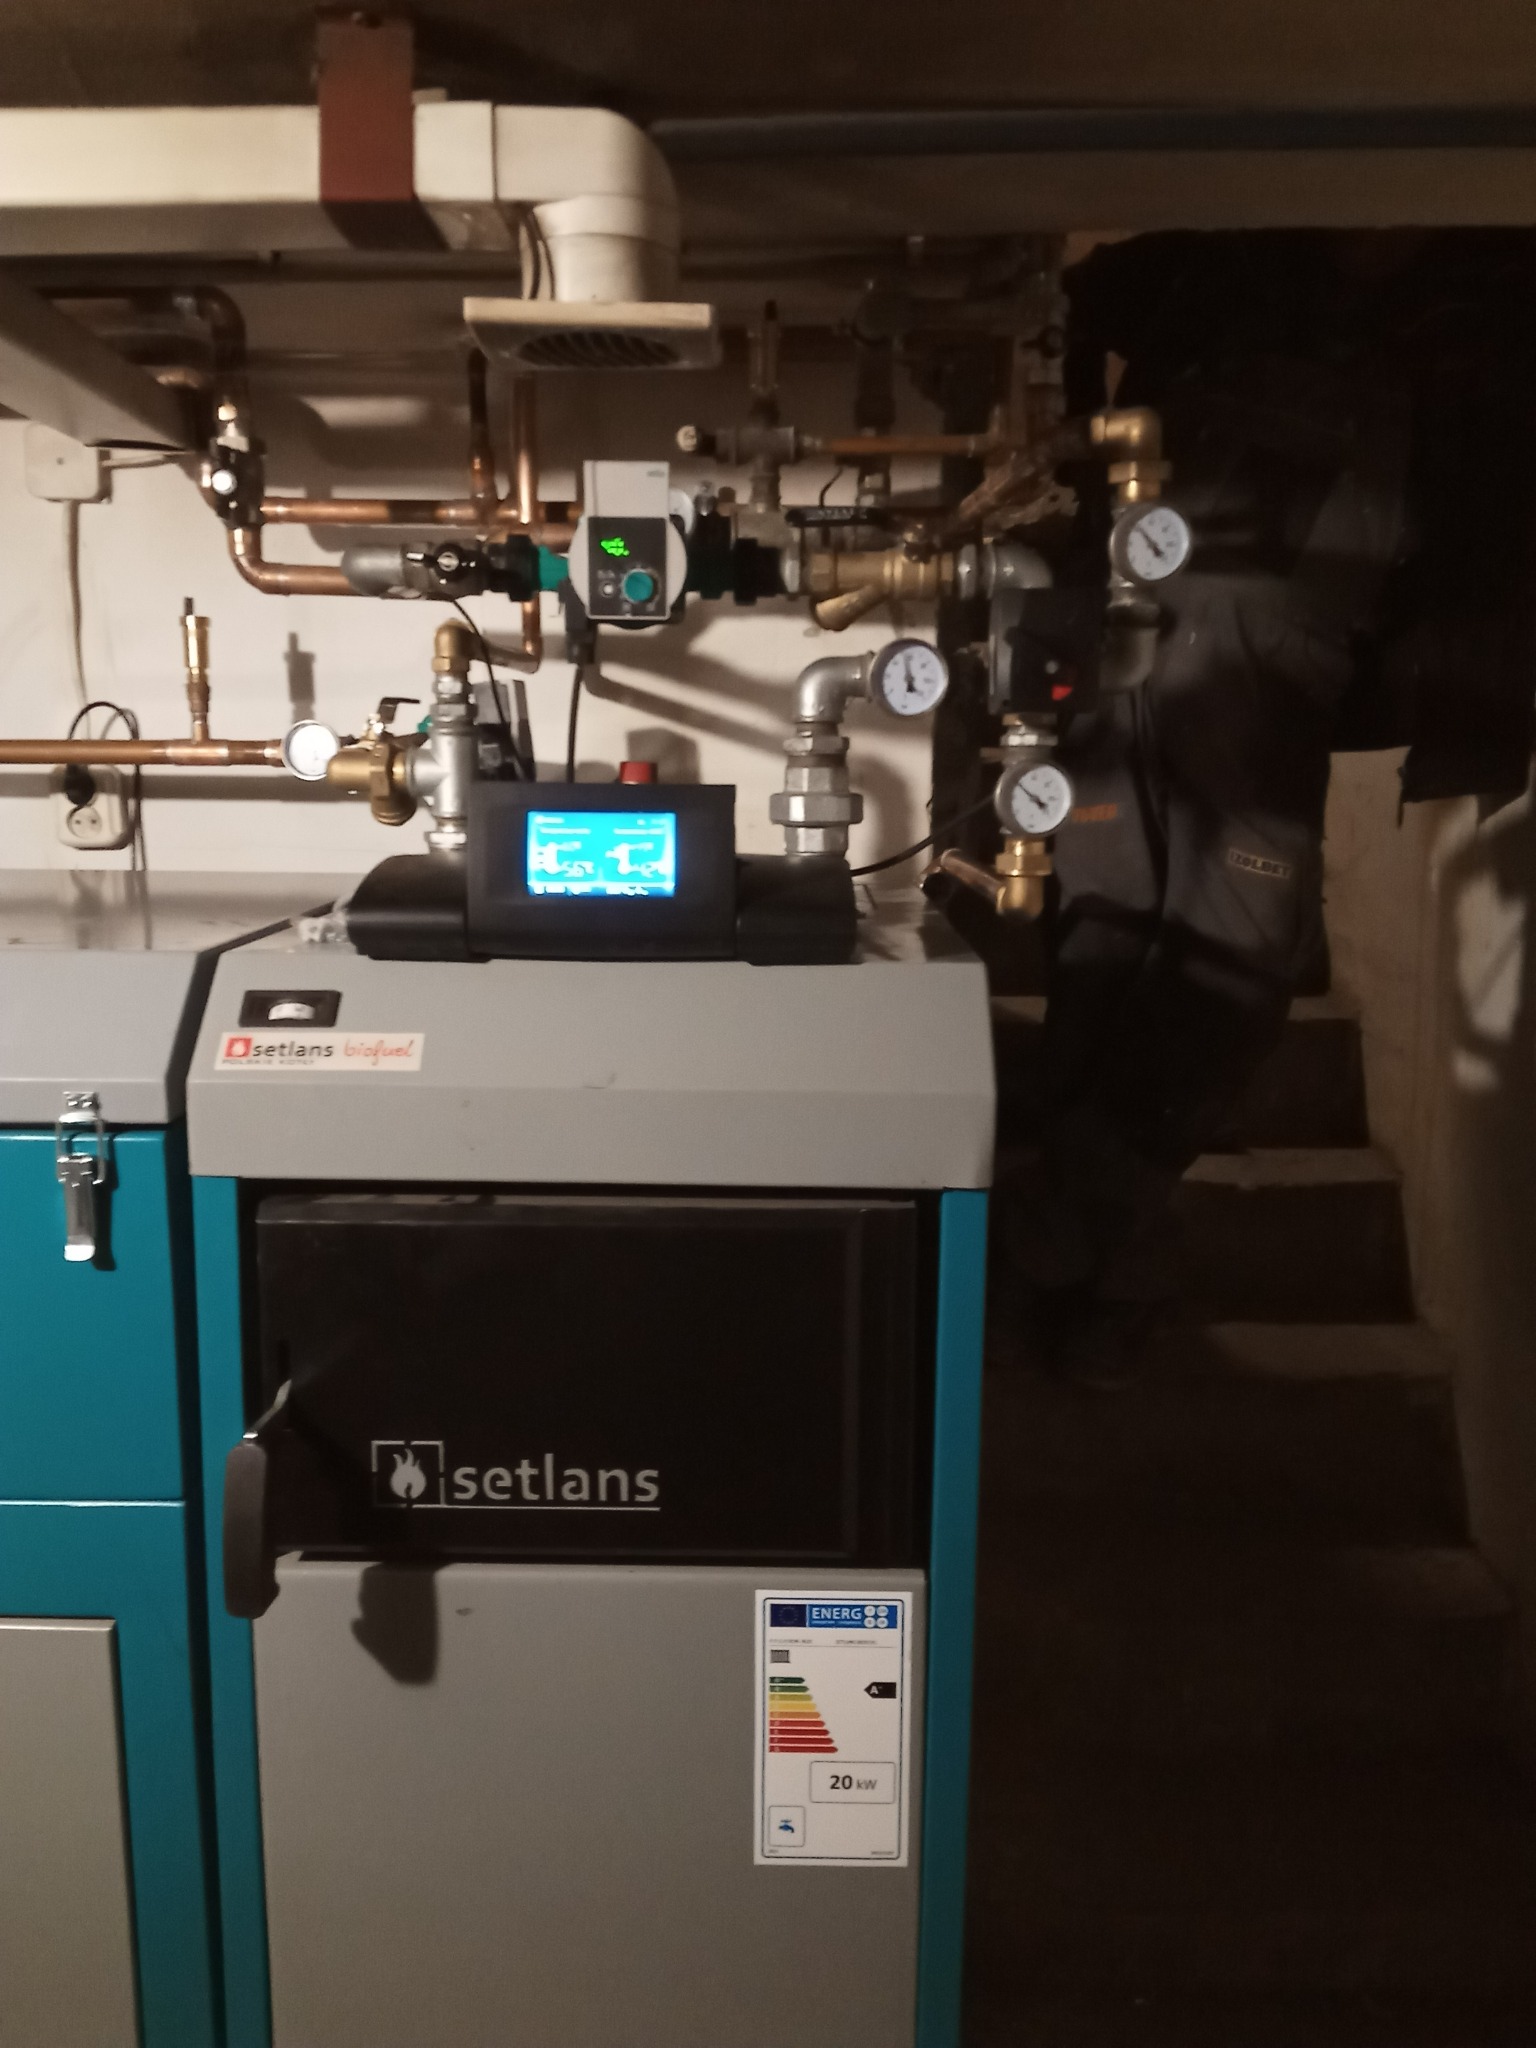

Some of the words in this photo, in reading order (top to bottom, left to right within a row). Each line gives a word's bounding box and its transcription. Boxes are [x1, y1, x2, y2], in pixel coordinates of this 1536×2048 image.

[252, 1041, 334, 1058] setlans
[344, 1038, 414, 1066] biofuel
[453, 1453, 659, 1502] setlans
[812, 1607, 862, 1620] ENERG
[830, 1775, 853, 1790] 20
[856, 1779, 878, 1790] kW
